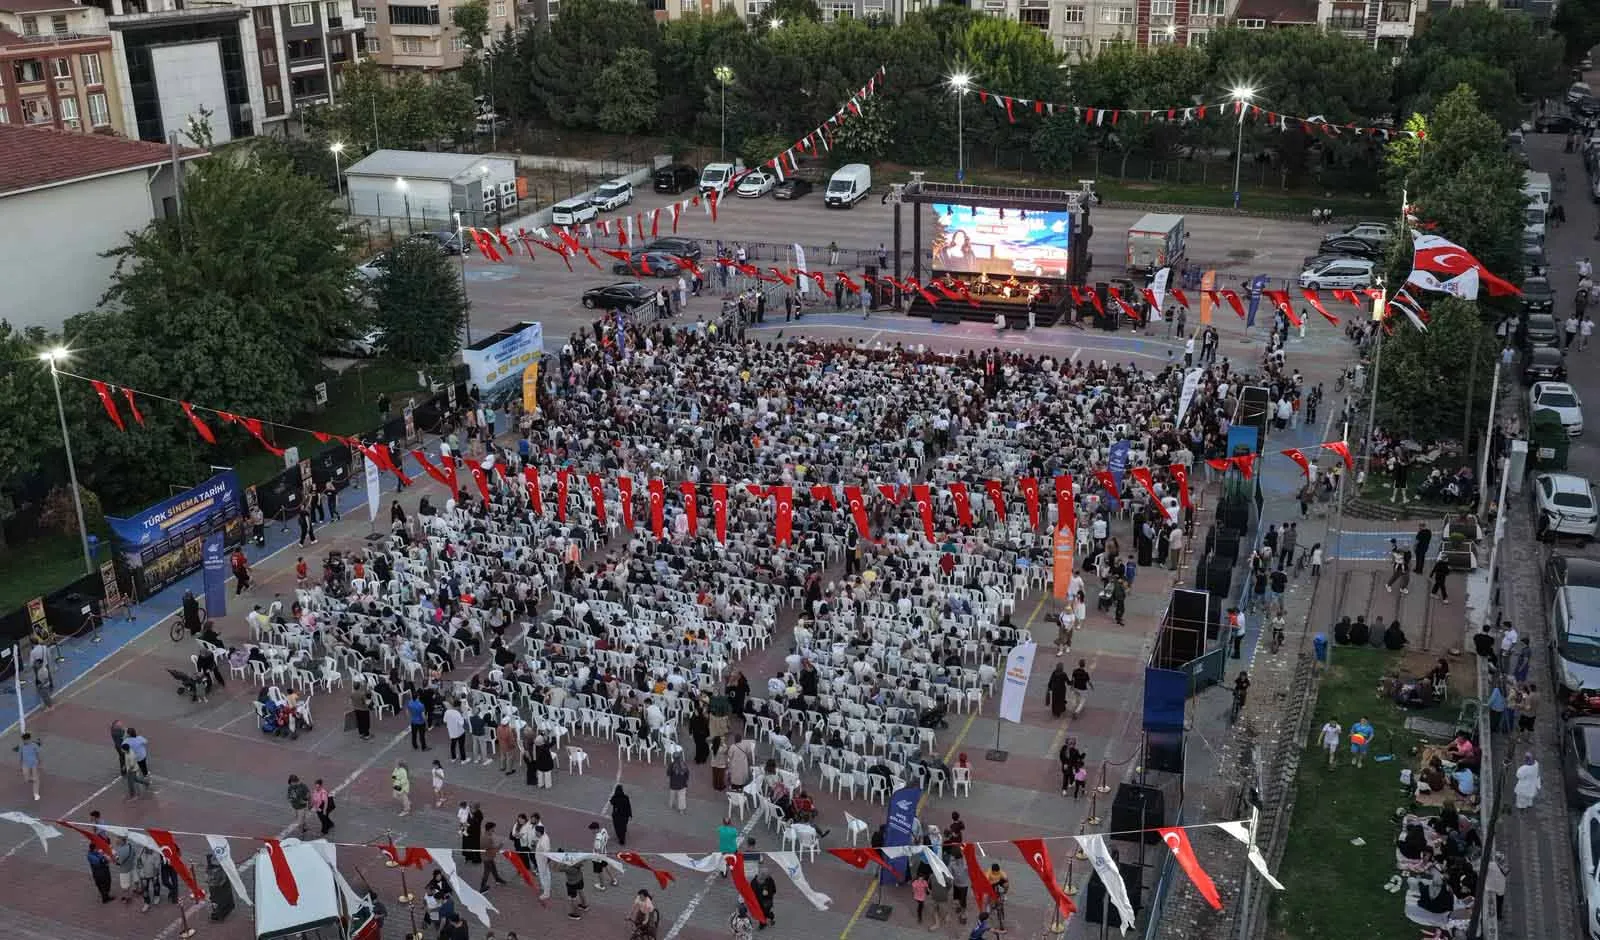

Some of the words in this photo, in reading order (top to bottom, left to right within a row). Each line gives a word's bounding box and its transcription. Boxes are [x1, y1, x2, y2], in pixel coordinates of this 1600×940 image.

[143, 511, 167, 529] TÜRK
[167, 496, 199, 517] SİNEMA
[199, 480, 226, 502] TARİHİ
